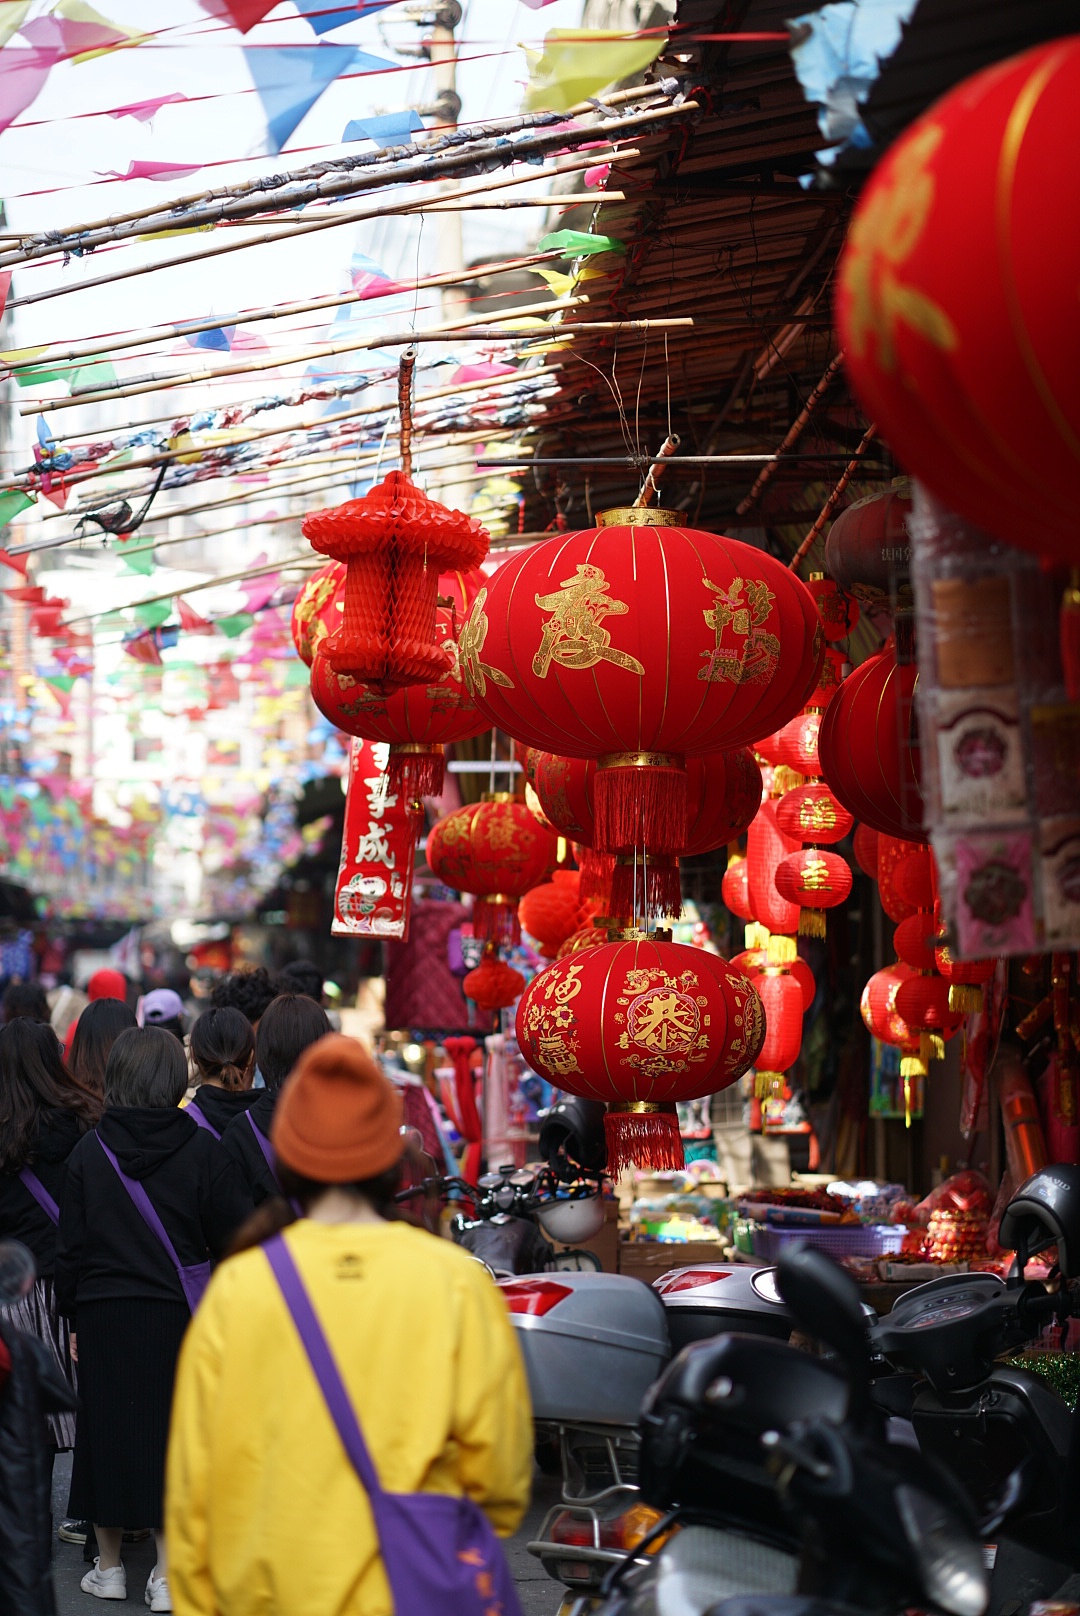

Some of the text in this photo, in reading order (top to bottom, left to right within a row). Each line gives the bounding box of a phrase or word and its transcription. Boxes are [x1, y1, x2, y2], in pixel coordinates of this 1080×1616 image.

[532, 563, 646, 679] 度
[544, 965, 584, 1005] 福
[663, 976, 678, 989] 財
[633, 993, 698, 1051] 恭
[614, 1031, 634, 1050] 喜
[696, 1034, 711, 1050] 發
[1039, 1174, 1071, 1191] DAVID
